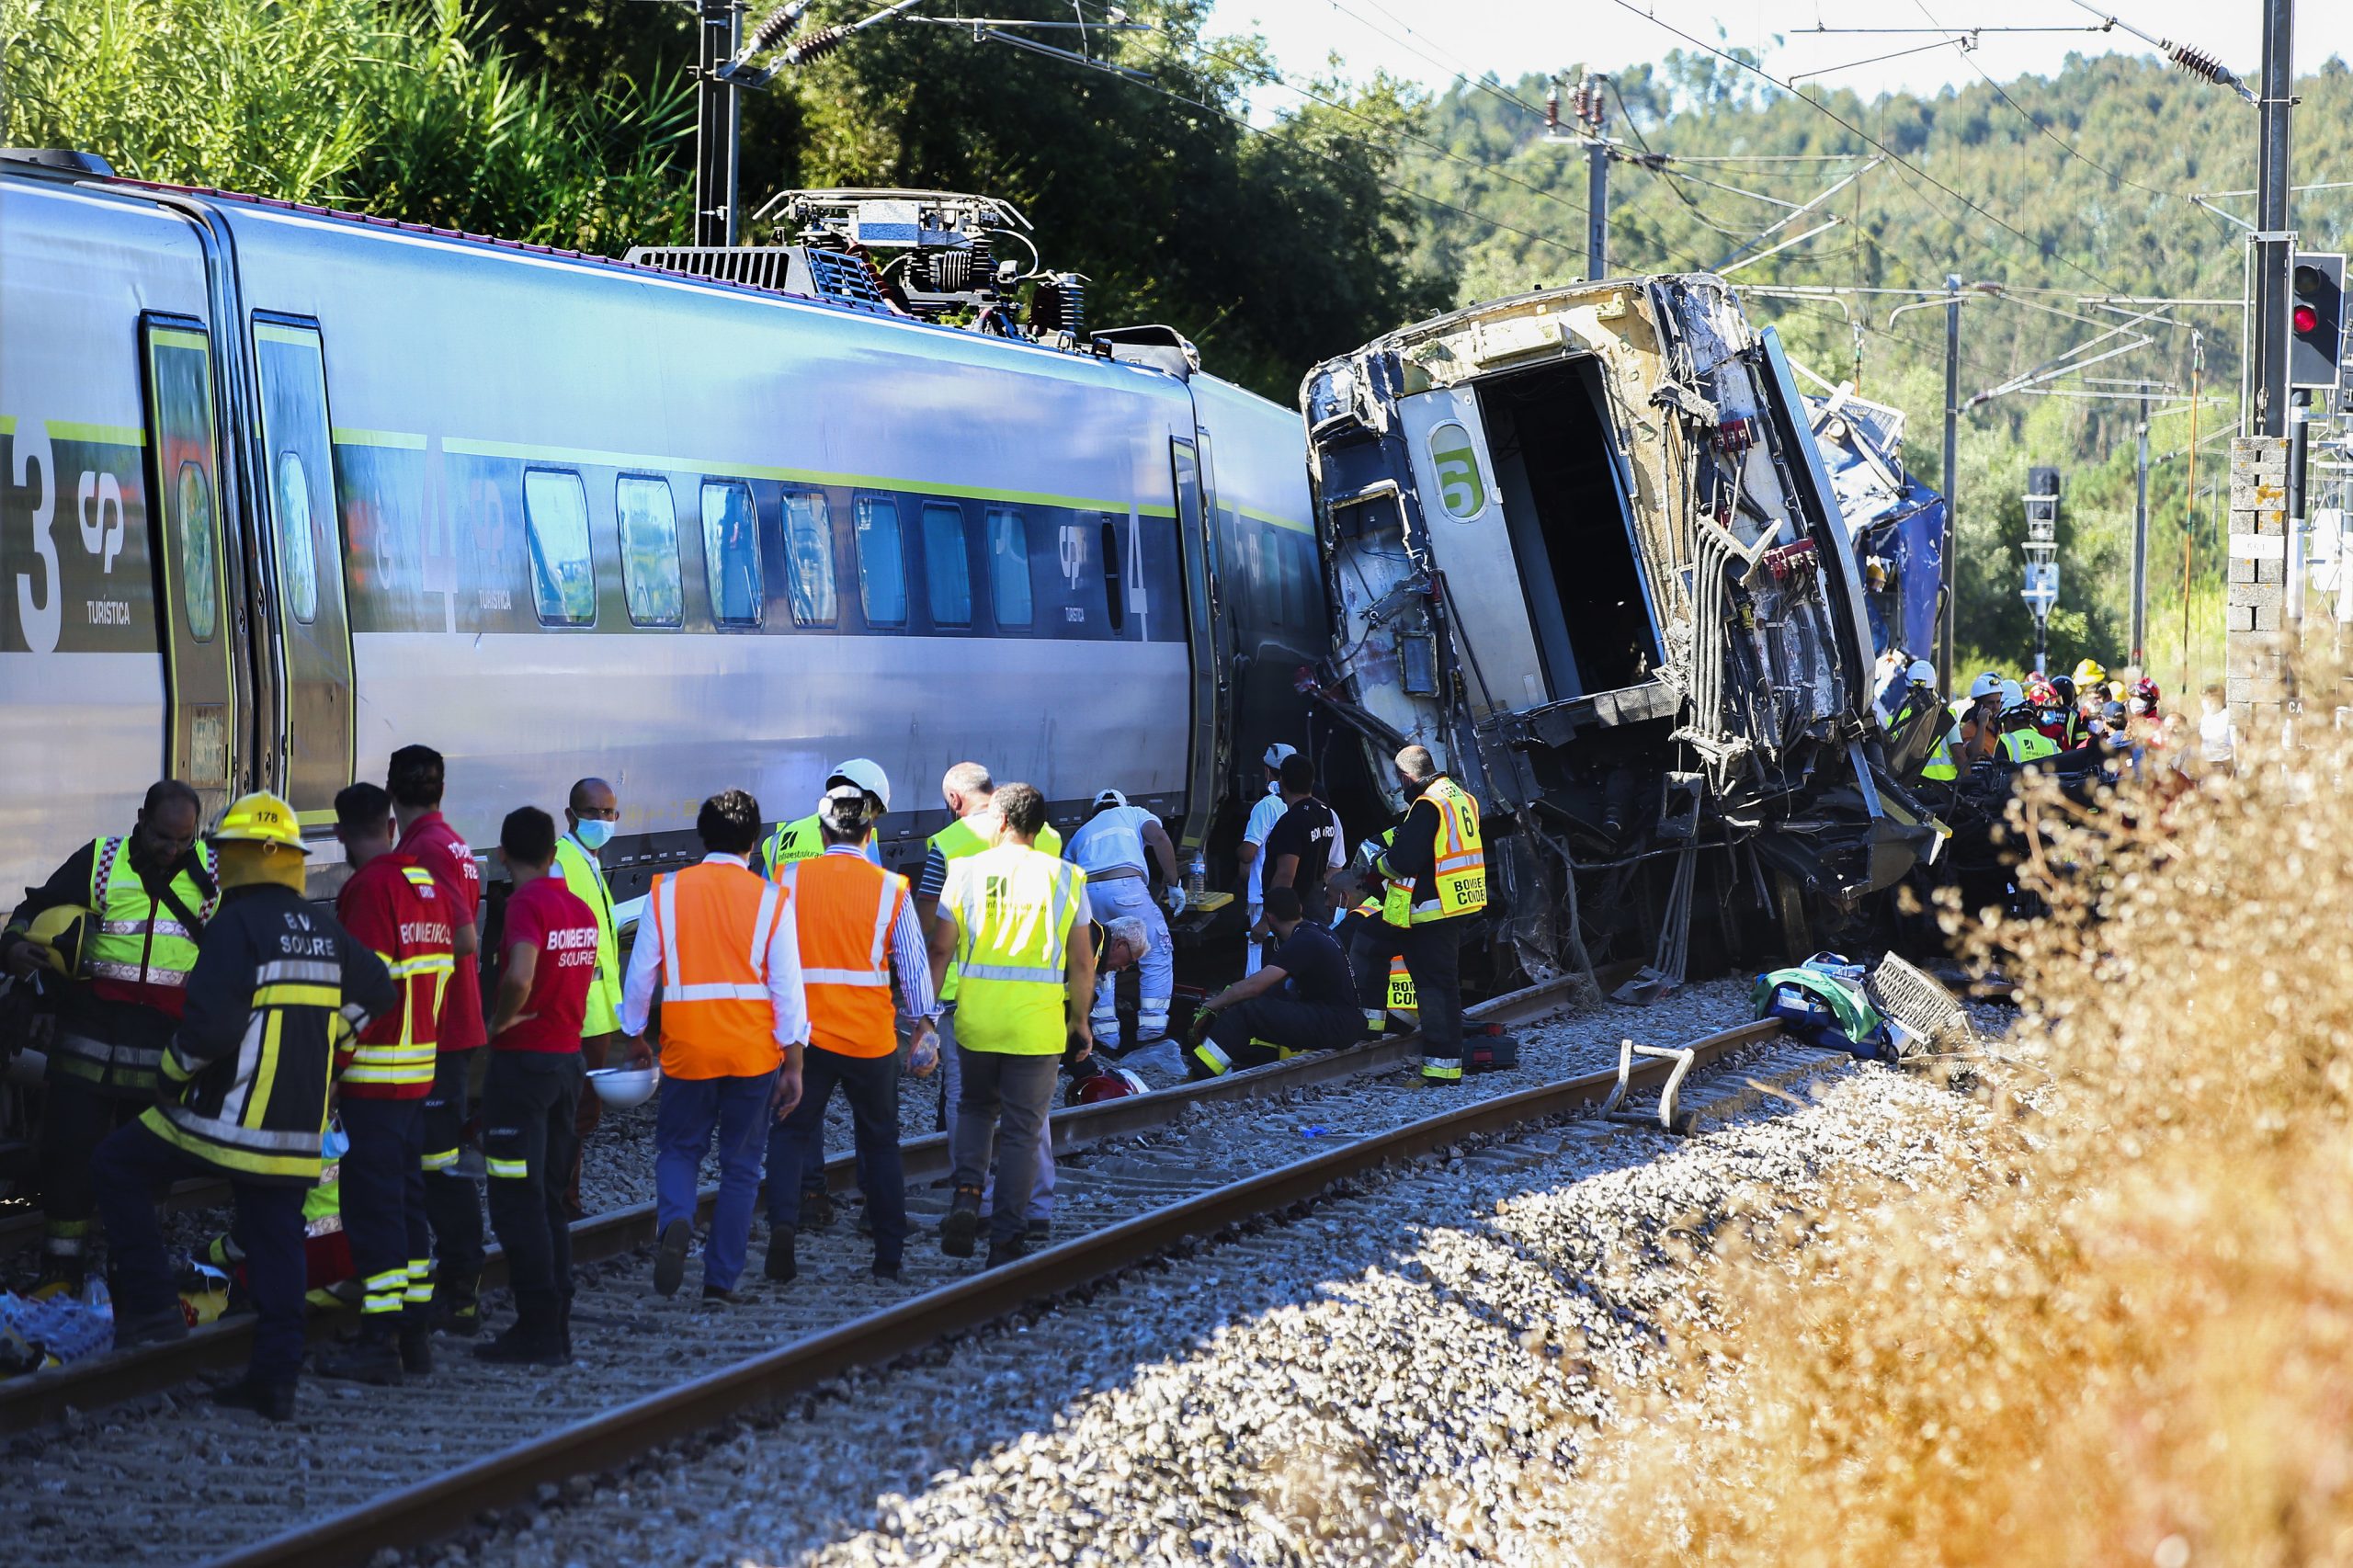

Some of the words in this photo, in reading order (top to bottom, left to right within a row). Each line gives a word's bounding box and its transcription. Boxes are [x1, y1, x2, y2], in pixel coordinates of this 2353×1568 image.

[1437, 460, 1474, 517] 6
[12, 414, 62, 653] 3
[419, 434, 459, 633] 4
[1127, 501, 1148, 642] 4
[86, 594, 131, 626] TURÍSTICA
[257, 811, 278, 824] 178
[1461, 805, 1473, 837] 6
[280, 935, 335, 957] SOURE
[558, 949, 596, 968] SOURE
